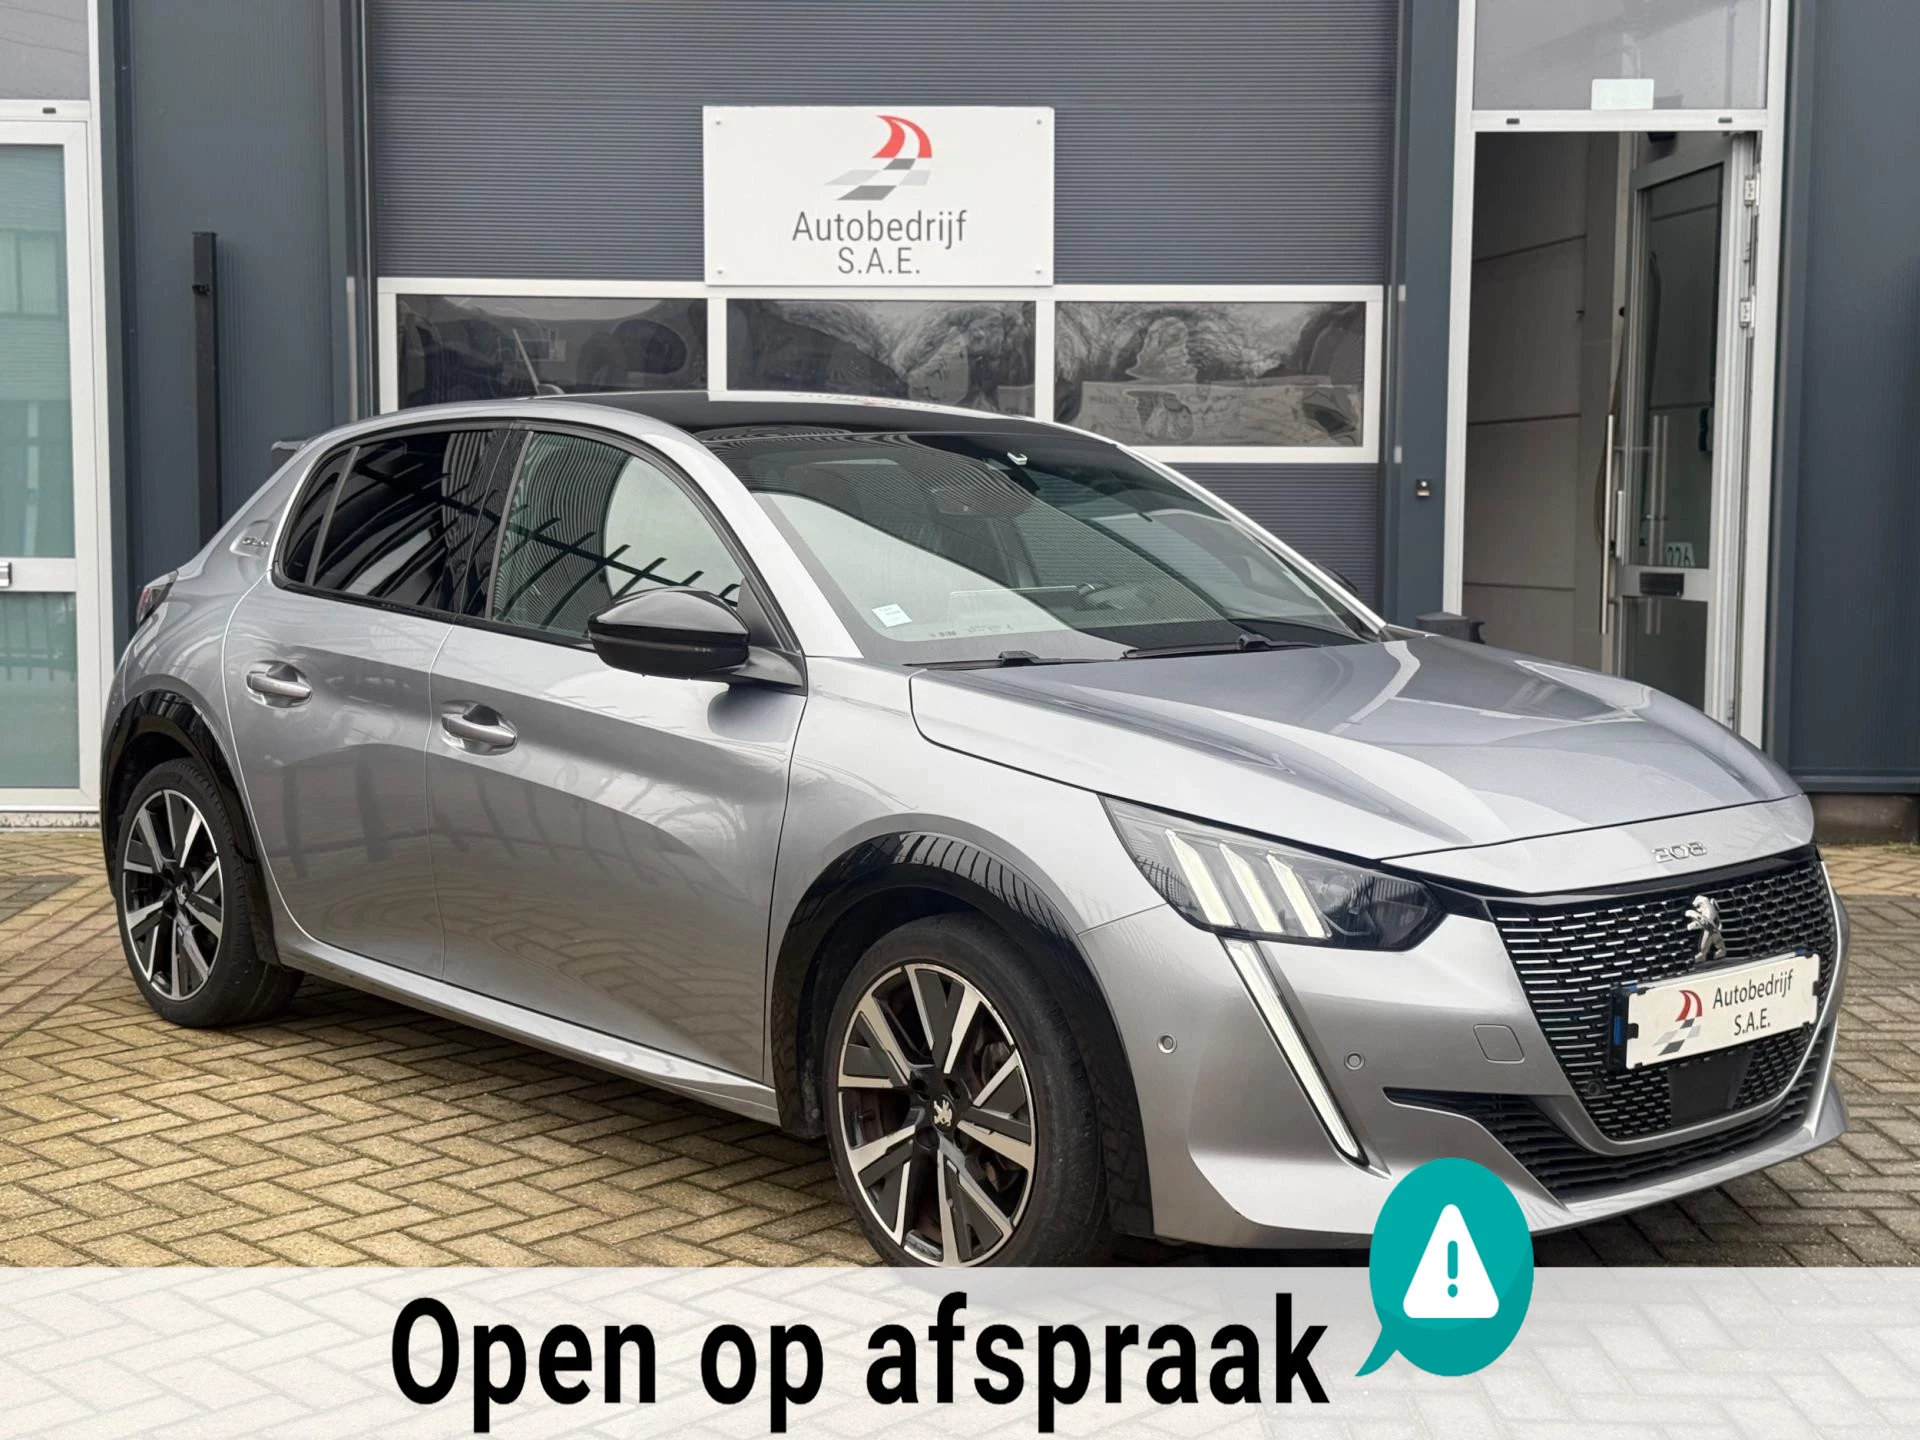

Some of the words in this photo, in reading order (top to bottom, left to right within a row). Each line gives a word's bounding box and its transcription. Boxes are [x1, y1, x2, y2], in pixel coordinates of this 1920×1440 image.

[792, 209, 967, 250] Autobedrijf
[838, 246, 920, 274] S.A.E.
[1652, 841, 1708, 863] 208
[1712, 969, 1793, 1009] Autobedrijf
[1733, 1008, 1771, 1036] S.A.E.
